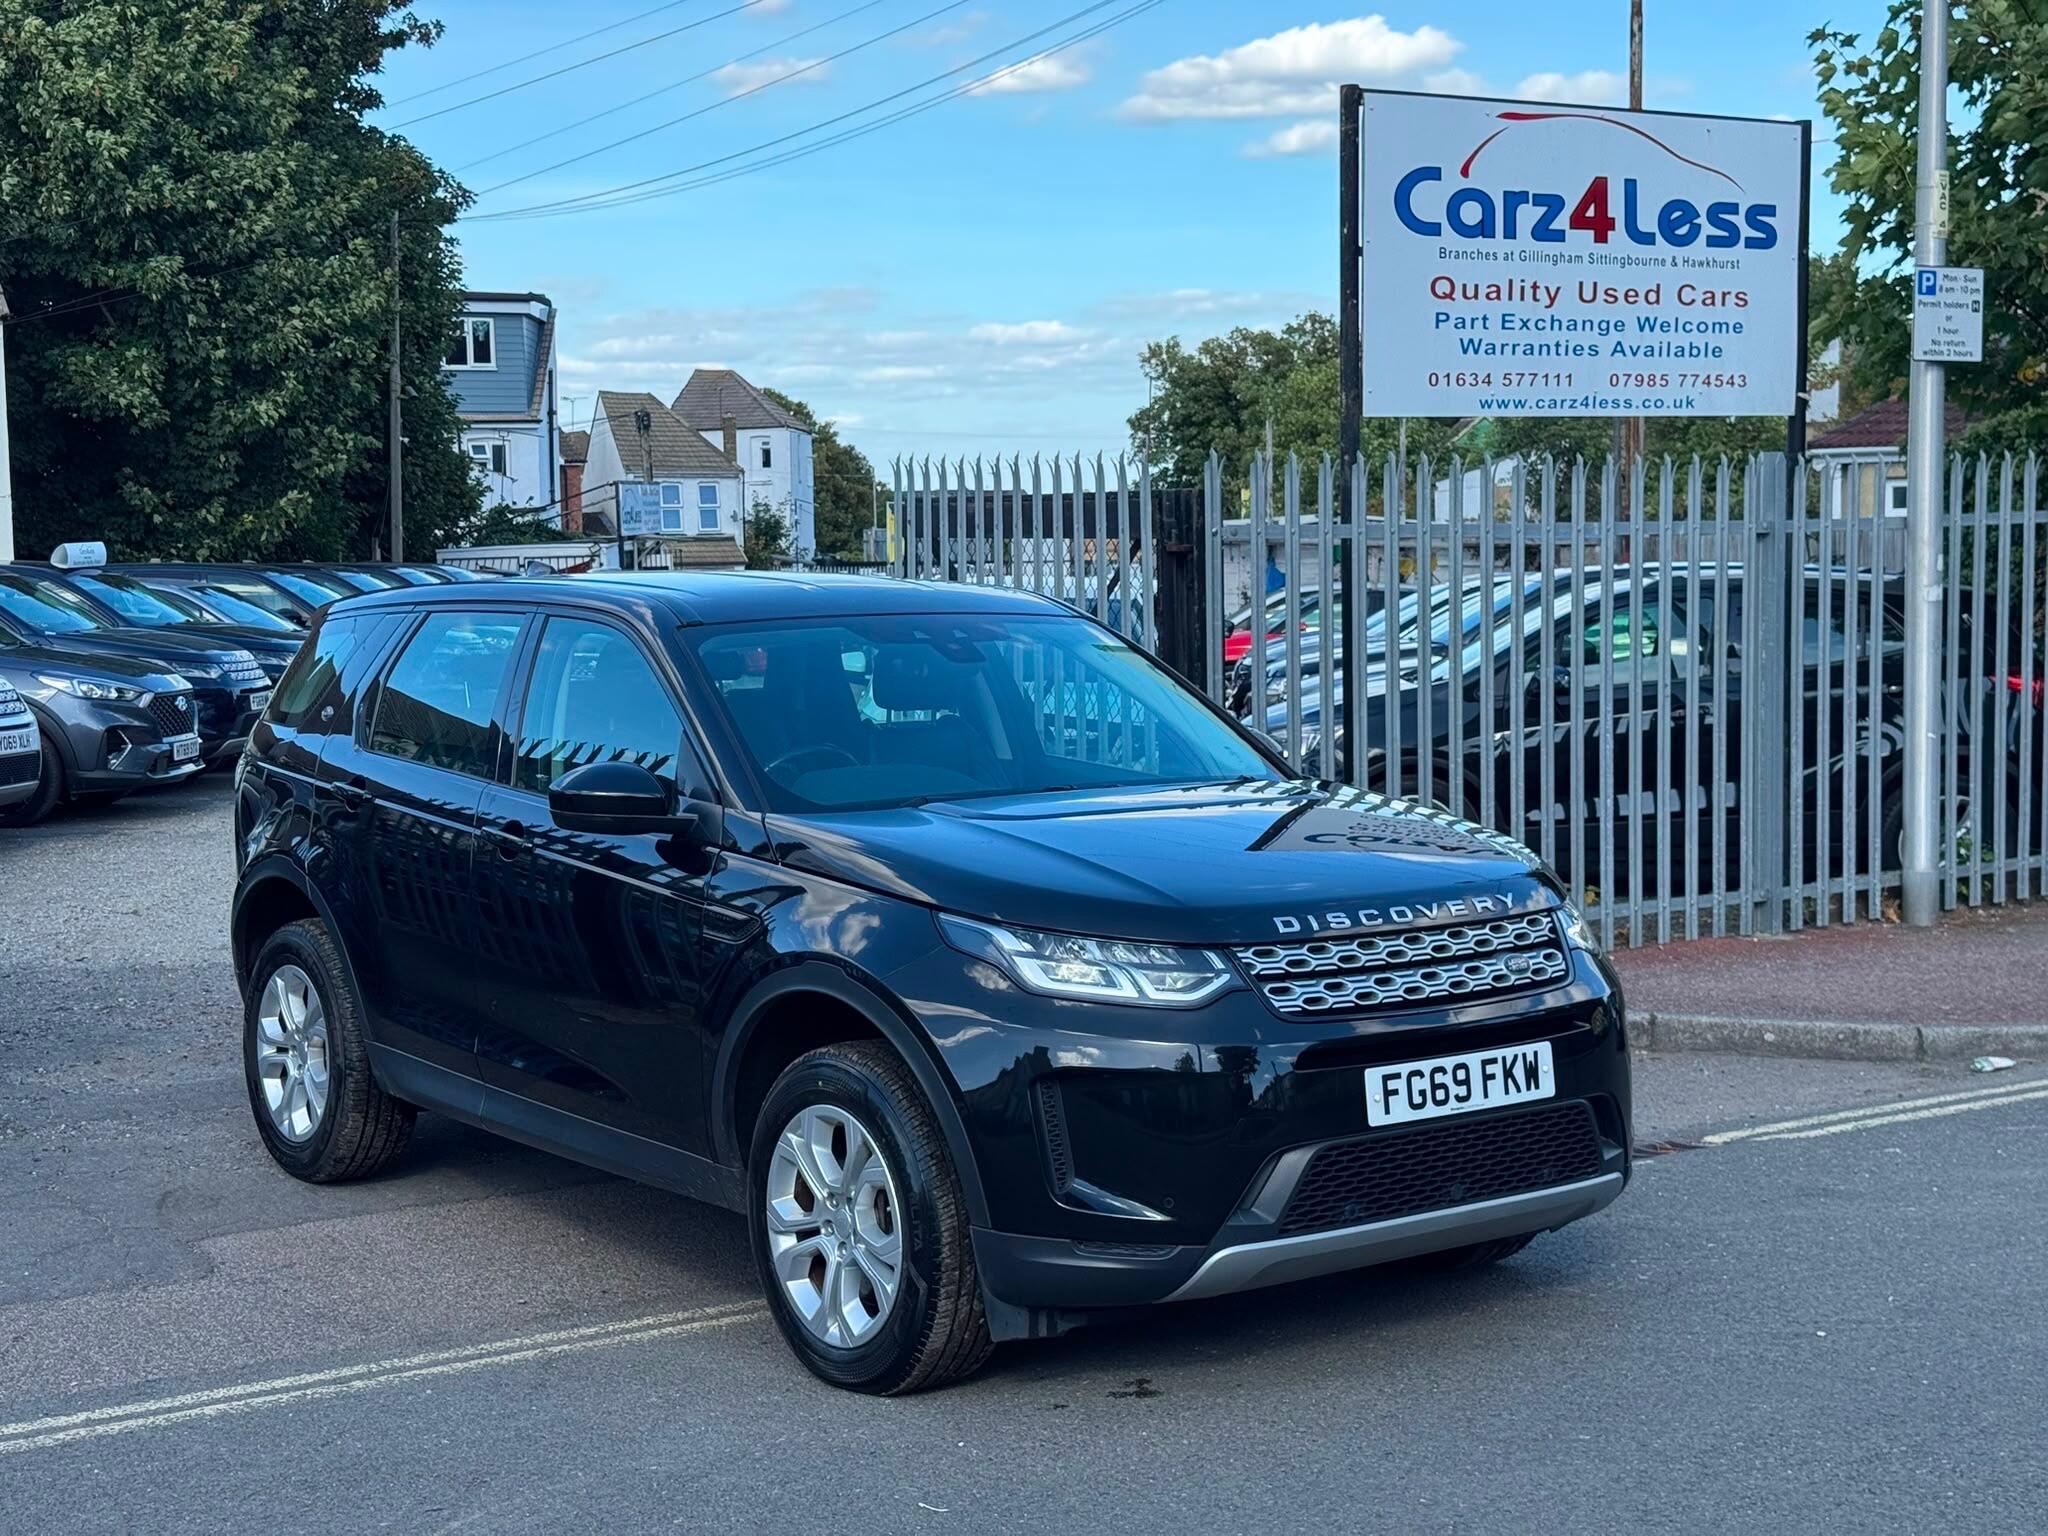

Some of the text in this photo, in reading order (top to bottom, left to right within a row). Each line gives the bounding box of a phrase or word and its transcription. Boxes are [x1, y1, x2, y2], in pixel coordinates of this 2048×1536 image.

[1394, 165, 1778, 250] Carz4Less
[1438, 246, 1740, 270] Branches at Gillingham Sittingbourne & Hawkhurst
[1921, 272, 1935, 294] P
[1942, 273, 1958, 282] Mon
[1963, 274, 1977, 283] Sun
[1430, 275, 1749, 309] Quality Used Cars
[1970, 287, 1981, 296] pm
[1918, 300, 1941, 310] Permit
[1943, 300, 1970, 310] holders
[1434, 311, 1744, 337] Part Exchange Welcome
[1945, 314, 1953, 322] or
[1942, 326, 1959, 335] hour
[1458, 337, 1723, 359] Warranties Available
[1930, 338, 1966, 348] No return
[1922, 348, 1945, 357] within
[1953, 348, 1974, 358] hours
[1428, 372, 1748, 389] 01634 577111 07985 774543
[1478, 393, 1696, 410] www.carz4less.co.uk
[1273, 892, 1514, 934] DISCOVERY
[1381, 1050, 1541, 1116] FG69 FKW
